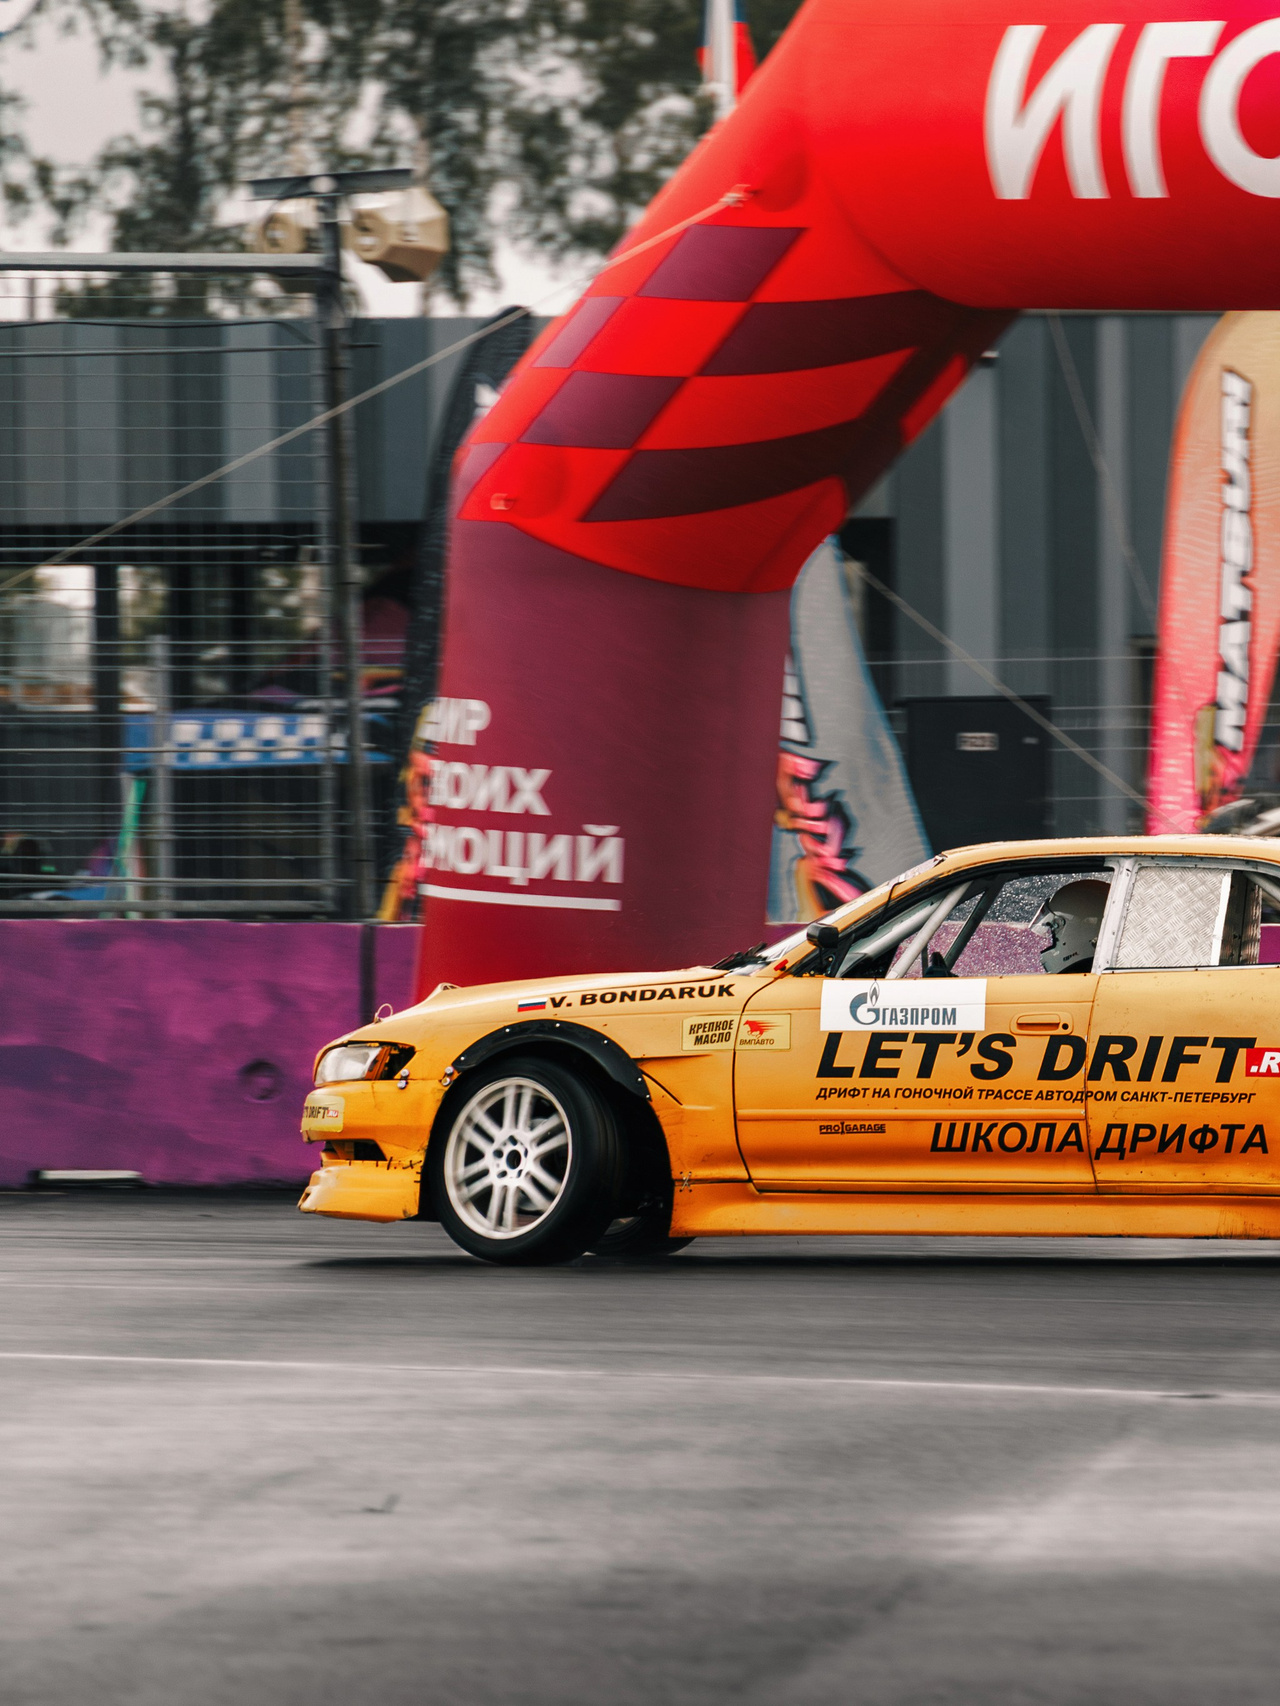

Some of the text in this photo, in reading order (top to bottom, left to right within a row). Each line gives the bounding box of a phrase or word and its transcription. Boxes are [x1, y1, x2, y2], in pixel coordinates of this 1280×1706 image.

[421, 824, 625, 885] МОЦИЙ
[549, 984, 735, 1008] V. BONDARUK
[689, 1019, 734, 1035] КРЕПКОЕ
[882, 1007, 957, 1026] ГАЗПРОМ
[694, 1031, 731, 1046] МАСЛО
[816, 1032, 1017, 1080] LET'S
[816, 1086, 1257, 1104] ДРИФТ НА ГОНОЧНОЙ ТРАССЕ АВТОДРОМ САНКТ-ПЕТЕРБУРГ
[930, 1121, 1269, 1160] ШКОЛА ДРИФТА
